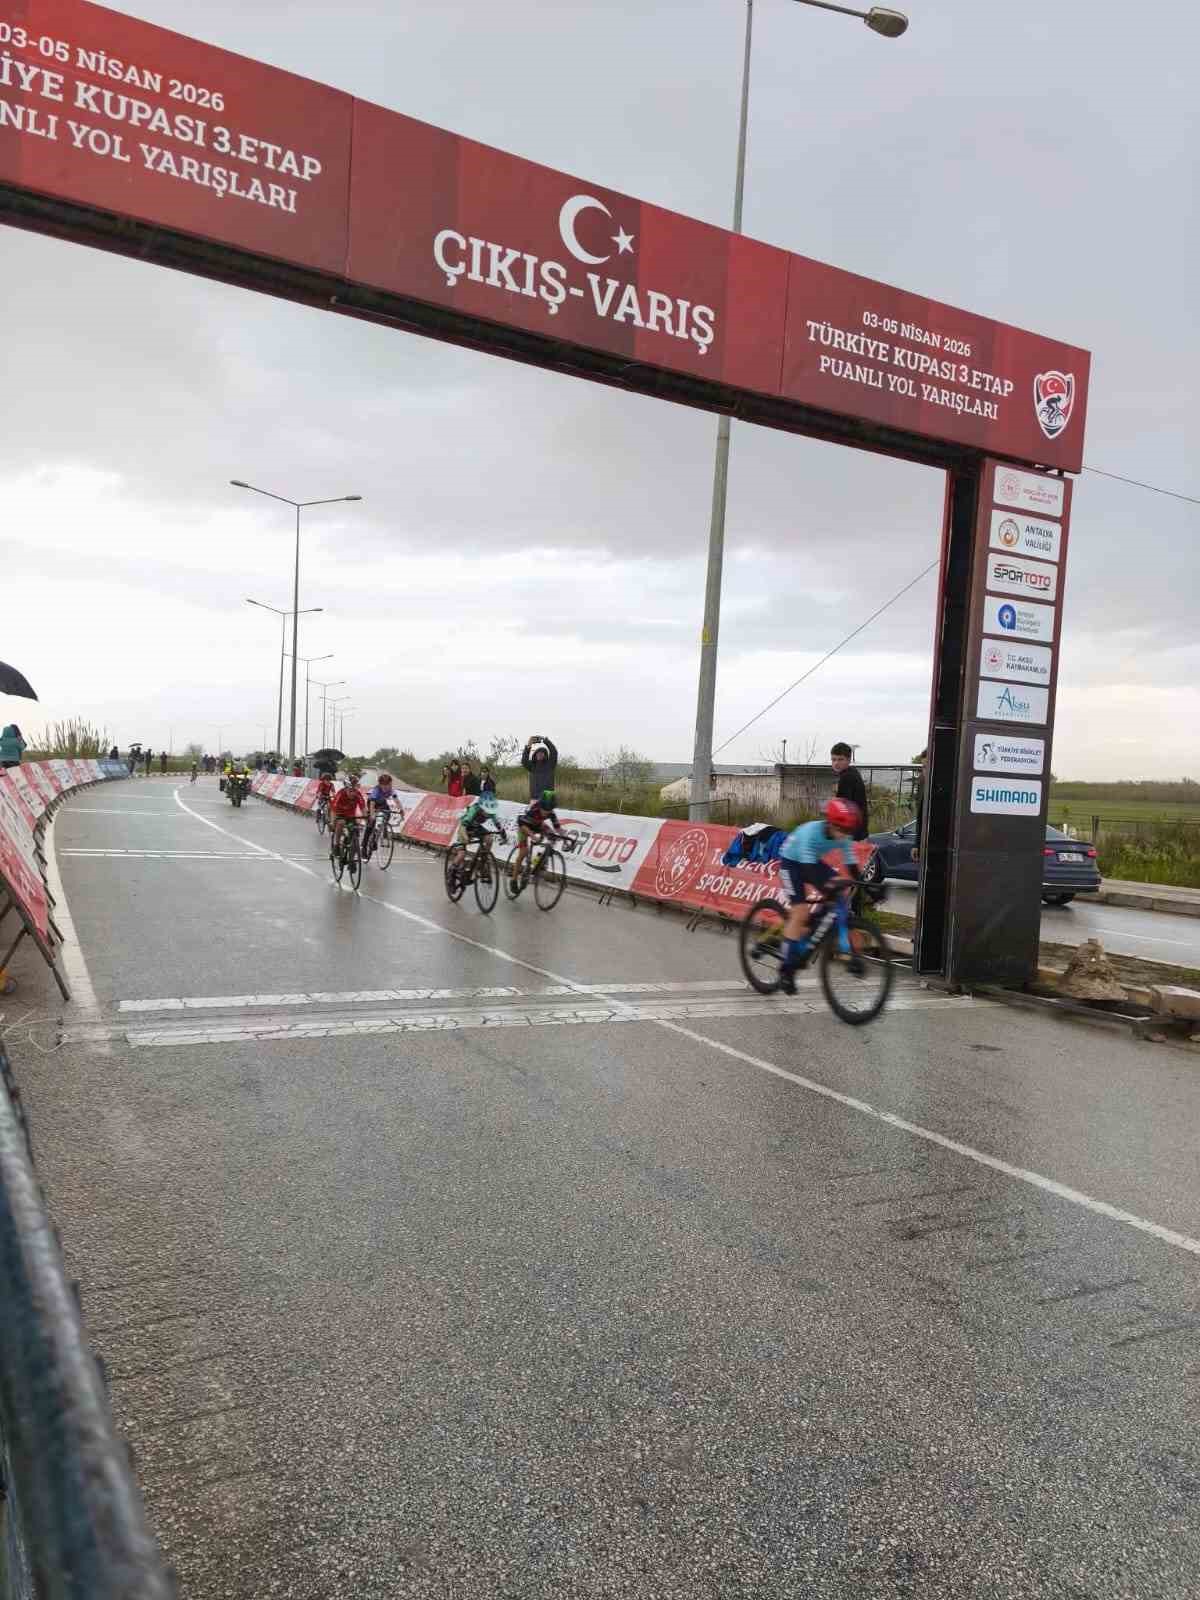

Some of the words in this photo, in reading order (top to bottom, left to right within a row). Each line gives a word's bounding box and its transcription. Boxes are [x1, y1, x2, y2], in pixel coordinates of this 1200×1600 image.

[0, 22, 70, 62] 03-05
[76, 47, 163, 93] NİSAN
[168, 79, 225, 112] 2026
[74, 80, 207, 147] KUPASI
[213, 126, 322, 182] 3.ETAP
[67, 120, 131, 162] YOL
[139, 142, 297, 213] YARIŞLARI
[433, 229, 715, 355] ÇIKIŞ-VARIŞ
[806, 320, 890, 362] TÜRKİYE
[893, 346, 957, 383] KUPASI
[959, 364, 1014, 398] 3.ETAP
[863, 311, 898, 334] 03-05
[900, 323, 942, 348] NİSAN
[943, 337, 971, 357] 2026
[819, 355, 884, 389] PUANLI
[887, 376, 917, 398] YOL
[920, 384, 999, 420] YARIŞLARI
[1025, 525, 1053, 538] ANTALYA
[976, 788, 1037, 804] SHIMANO
[561, 829, 638, 863] ORTOTO
[695, 873, 731, 896] SPOR
